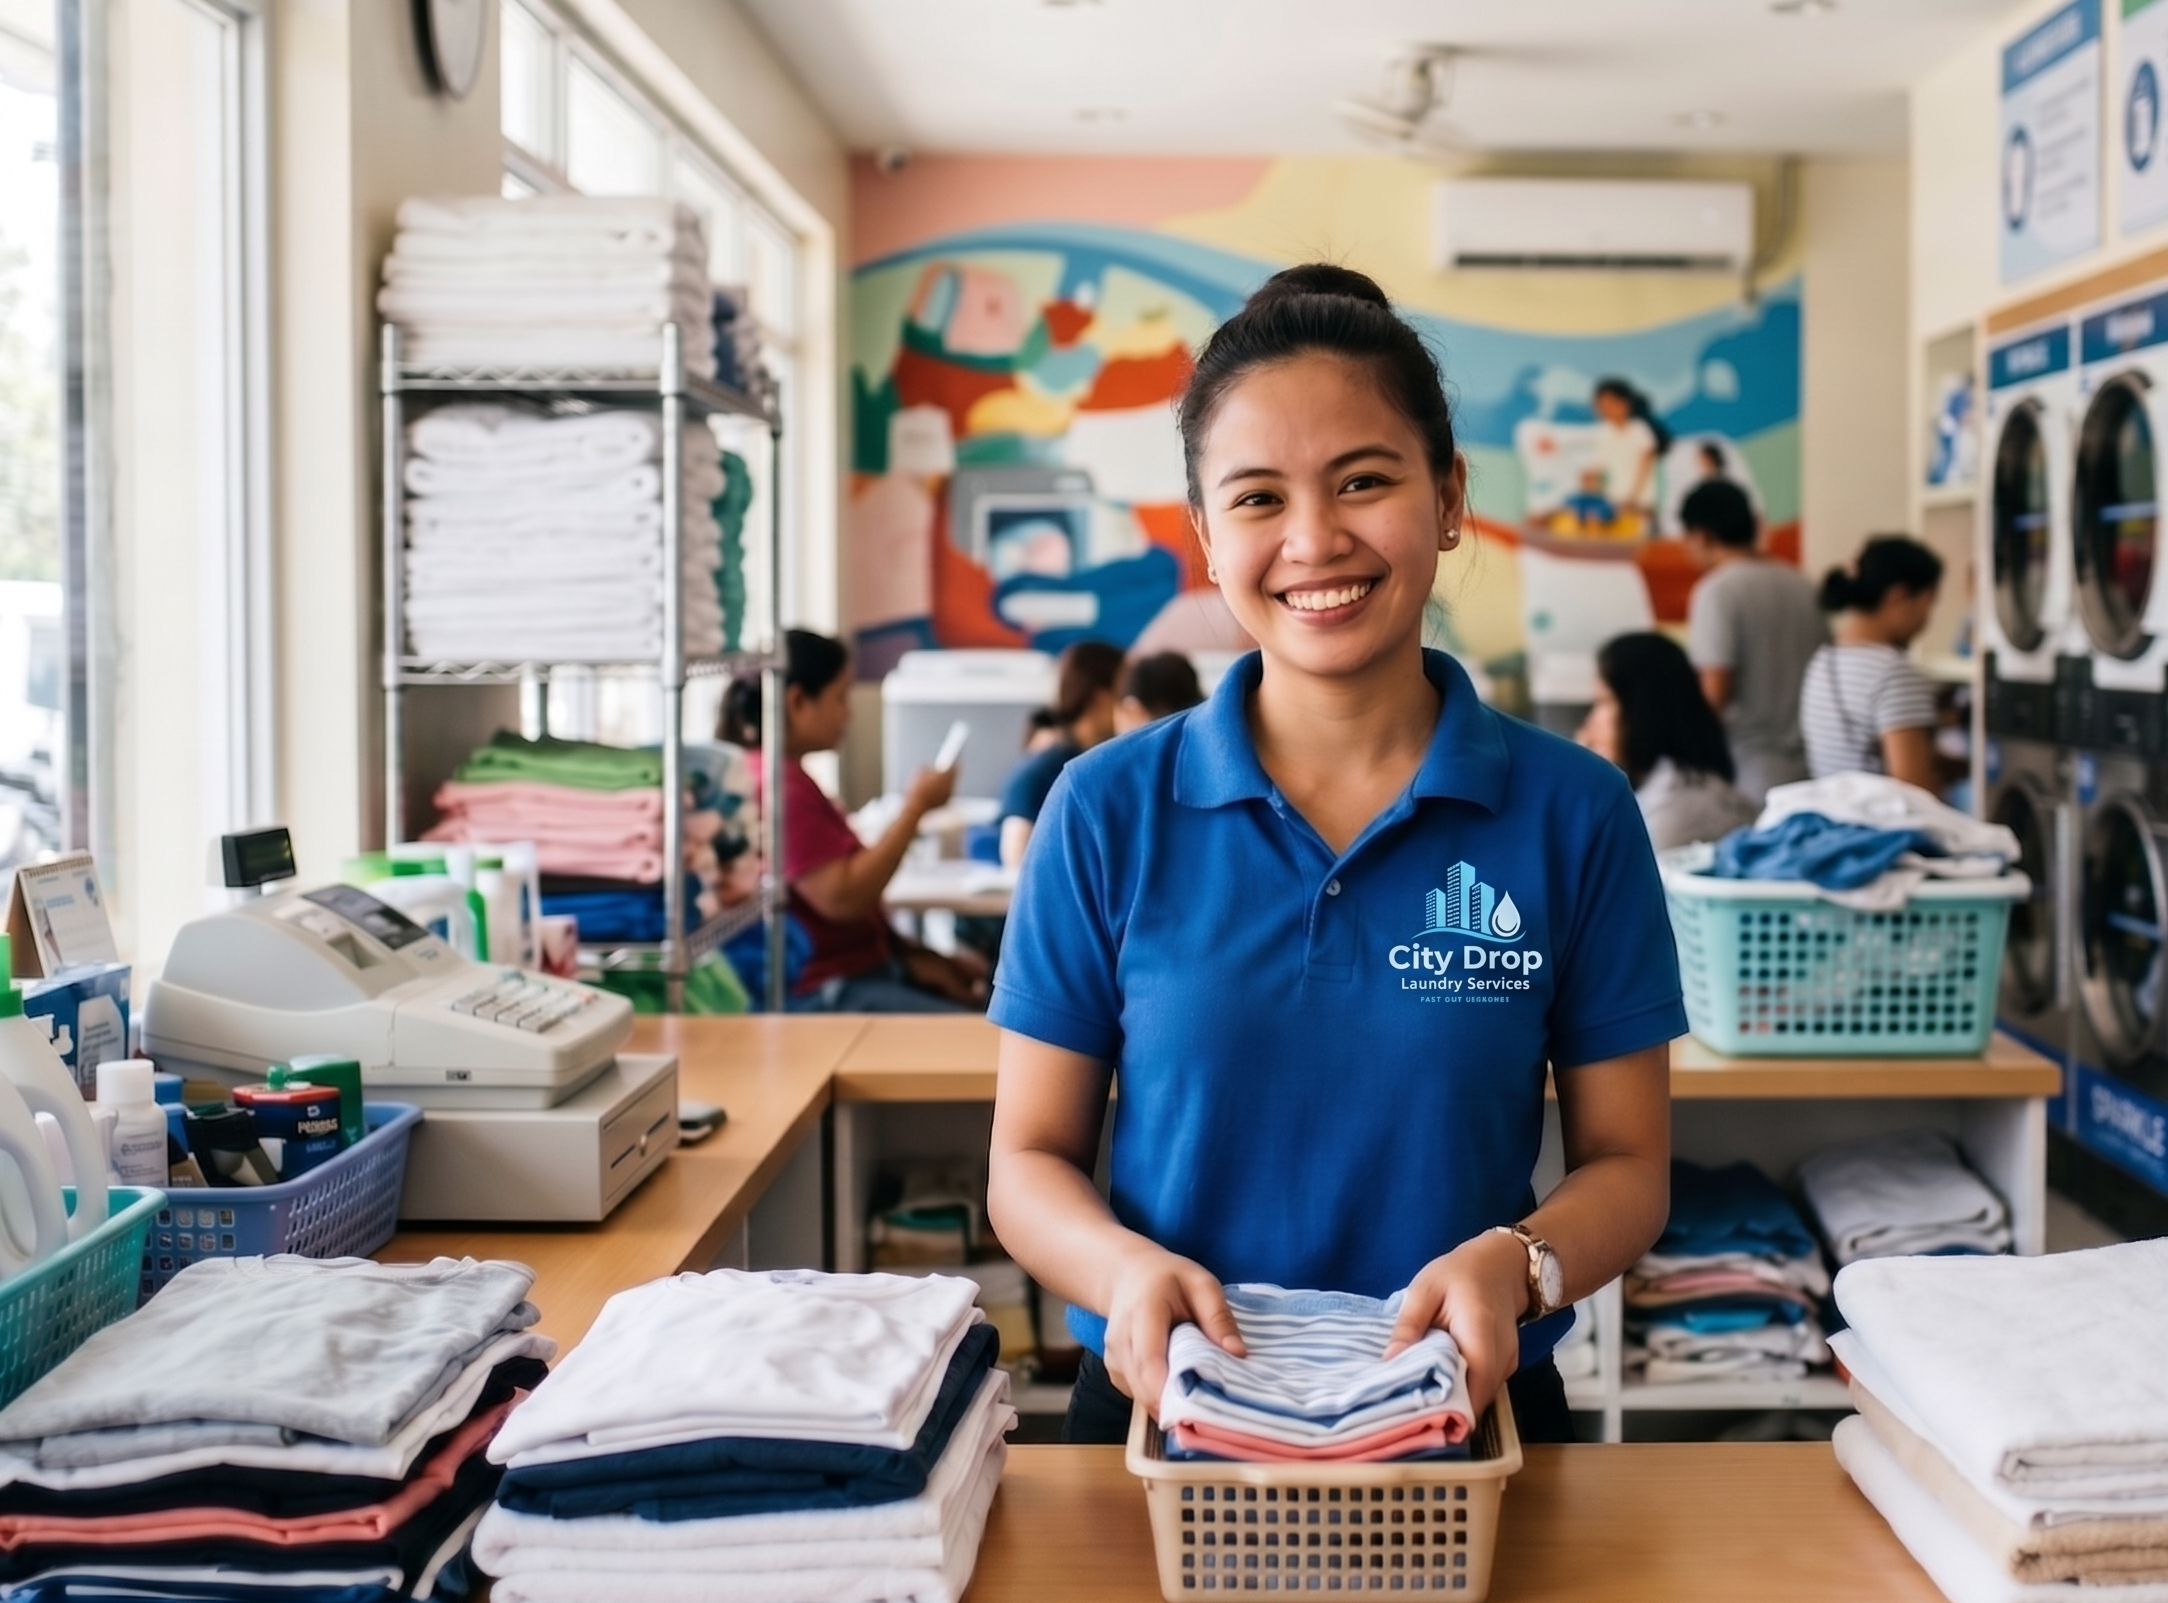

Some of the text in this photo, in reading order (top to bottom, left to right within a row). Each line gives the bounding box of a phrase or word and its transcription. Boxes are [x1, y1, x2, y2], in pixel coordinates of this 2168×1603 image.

[1388, 942, 1543, 976] City Drop
[1401, 977, 1530, 993] Laundry Services
